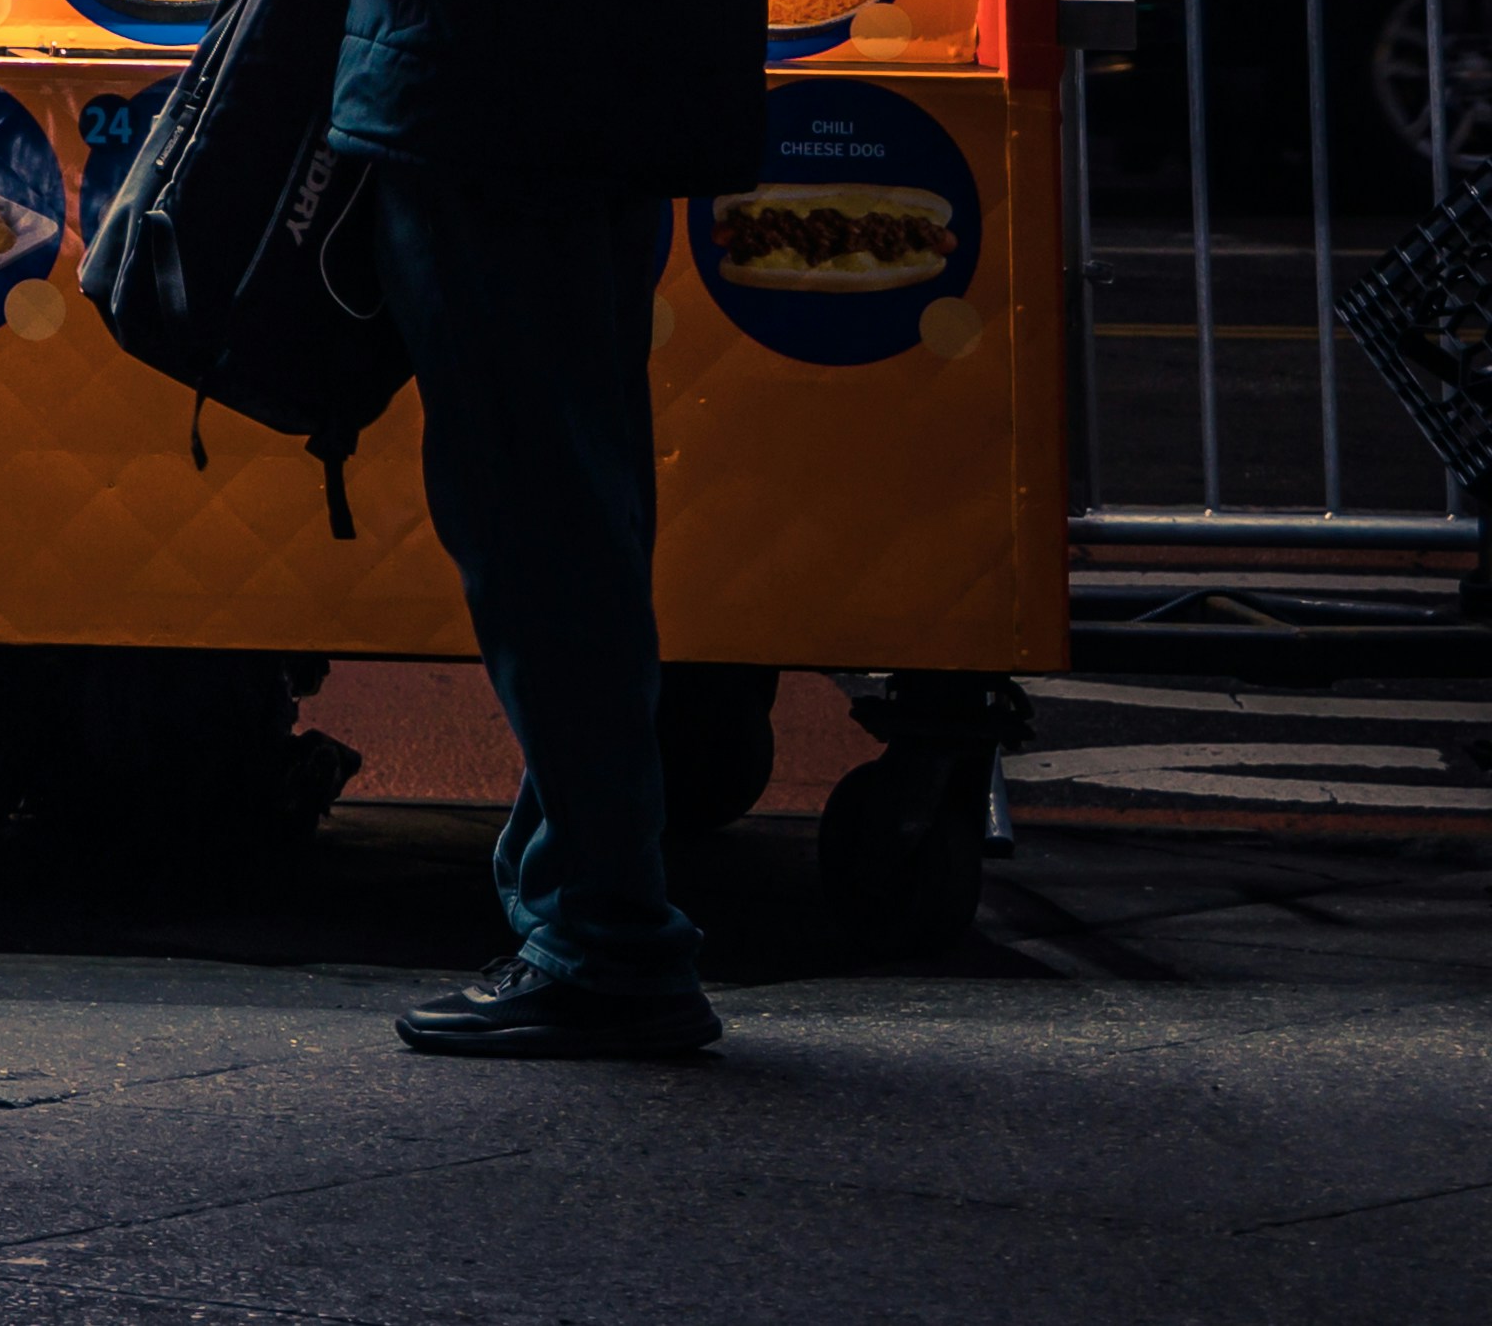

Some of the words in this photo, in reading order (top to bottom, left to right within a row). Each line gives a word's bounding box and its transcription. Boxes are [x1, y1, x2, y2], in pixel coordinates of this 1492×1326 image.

[84, 106, 133, 144] 24
[811, 120, 854, 135] CHILI
[780, 141, 844, 157] CHEESE
[849, 142, 885, 158] DOG
